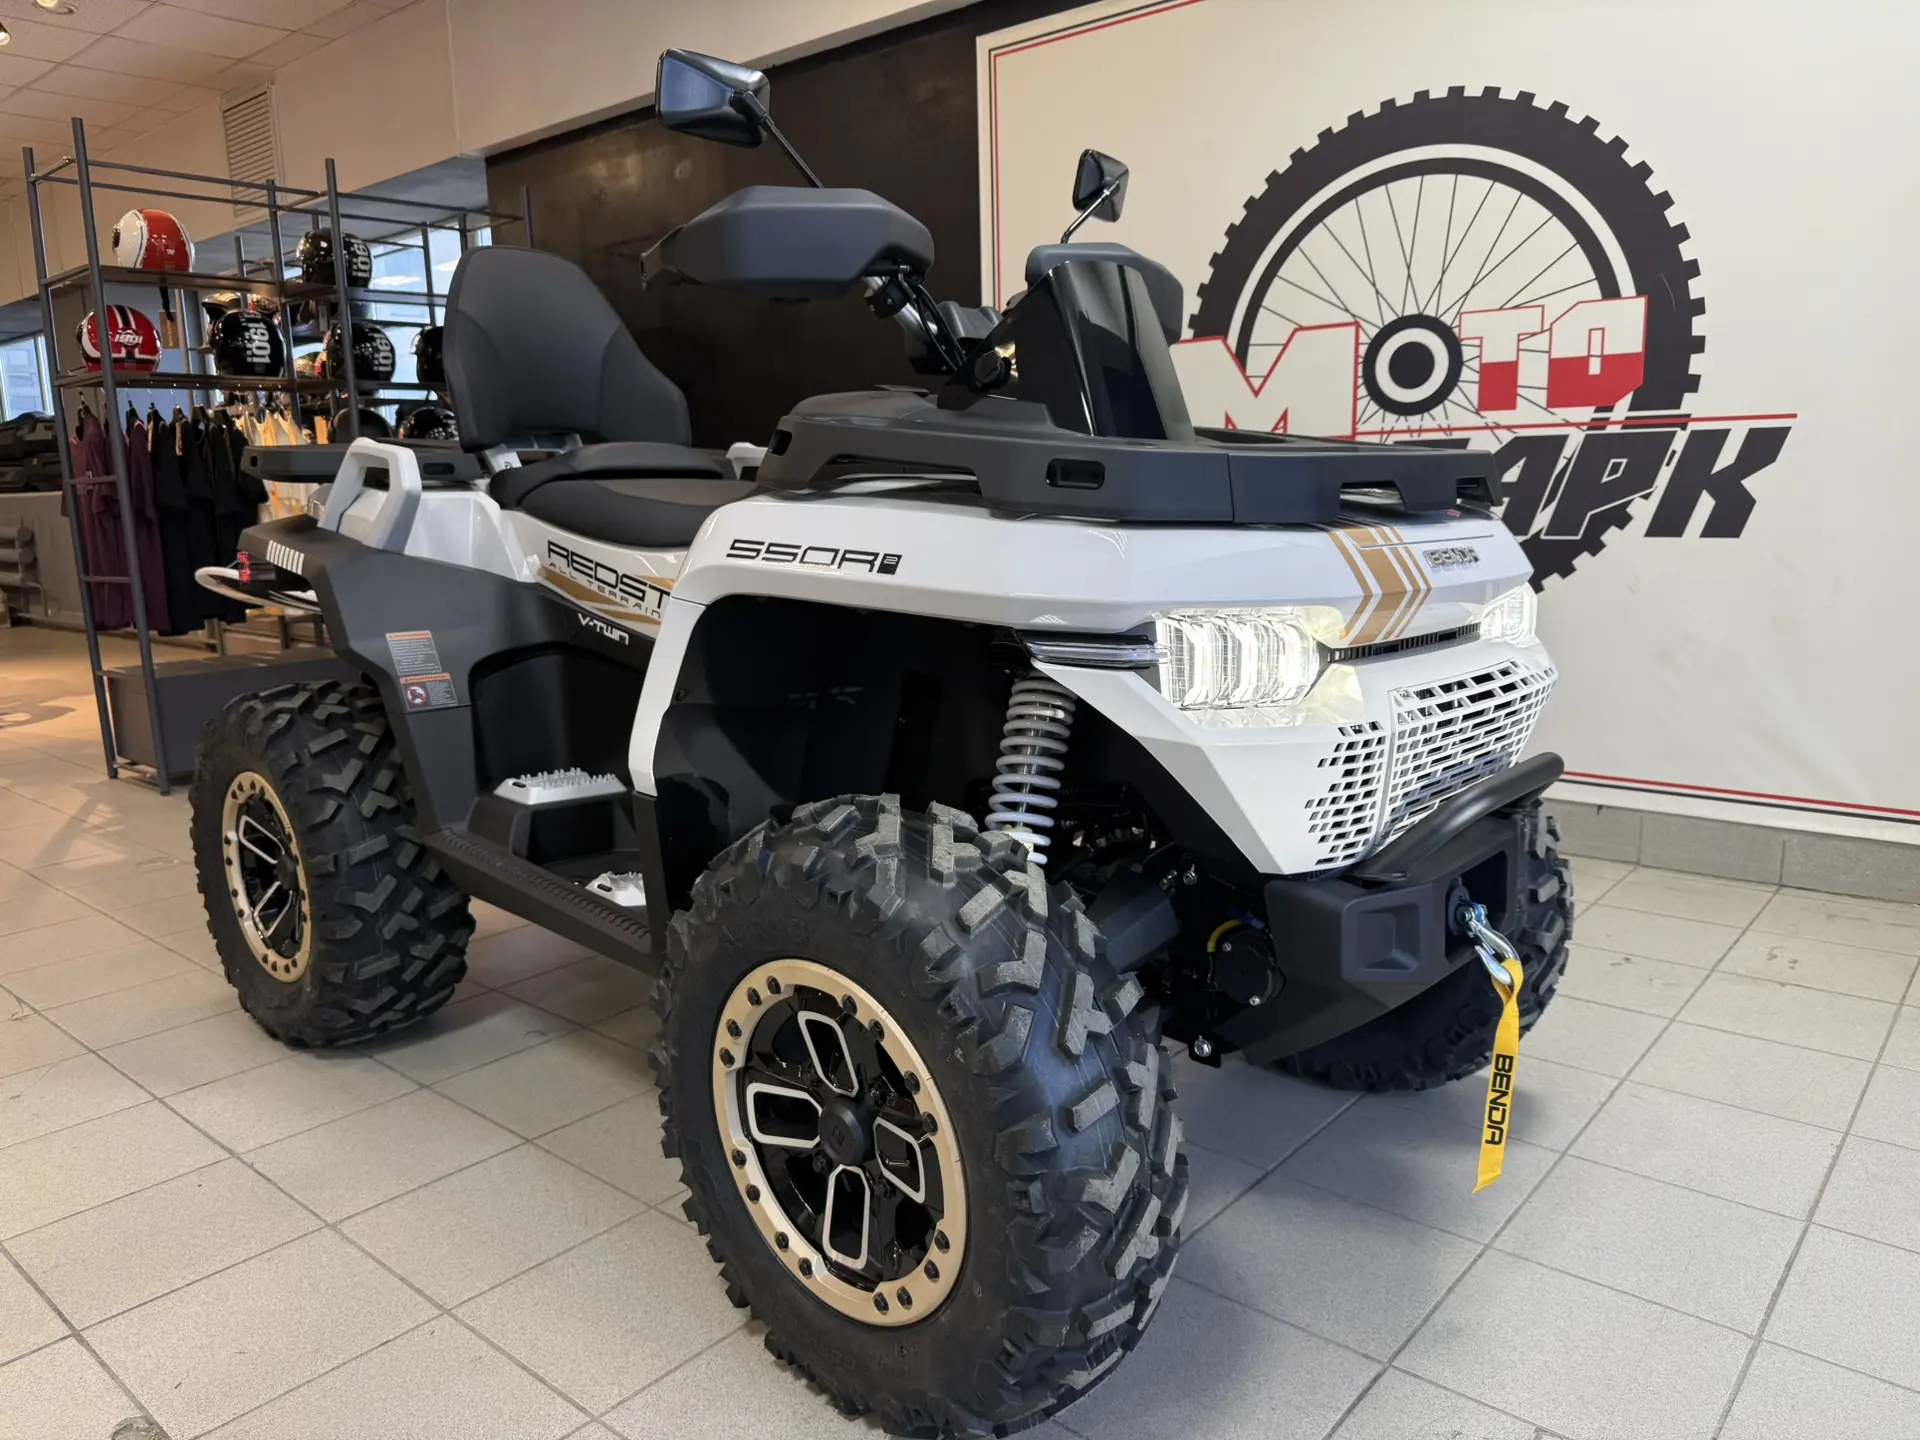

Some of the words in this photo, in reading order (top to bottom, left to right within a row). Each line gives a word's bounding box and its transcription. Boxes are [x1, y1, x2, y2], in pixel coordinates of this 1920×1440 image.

[247, 322, 271, 364] 1901
[1393, 426, 1792, 538] АРК
[549, 562, 578, 580] ALL
[587, 579, 661, 619] TERRAIN
[1485, 1053, 1514, 1146] BENDA
